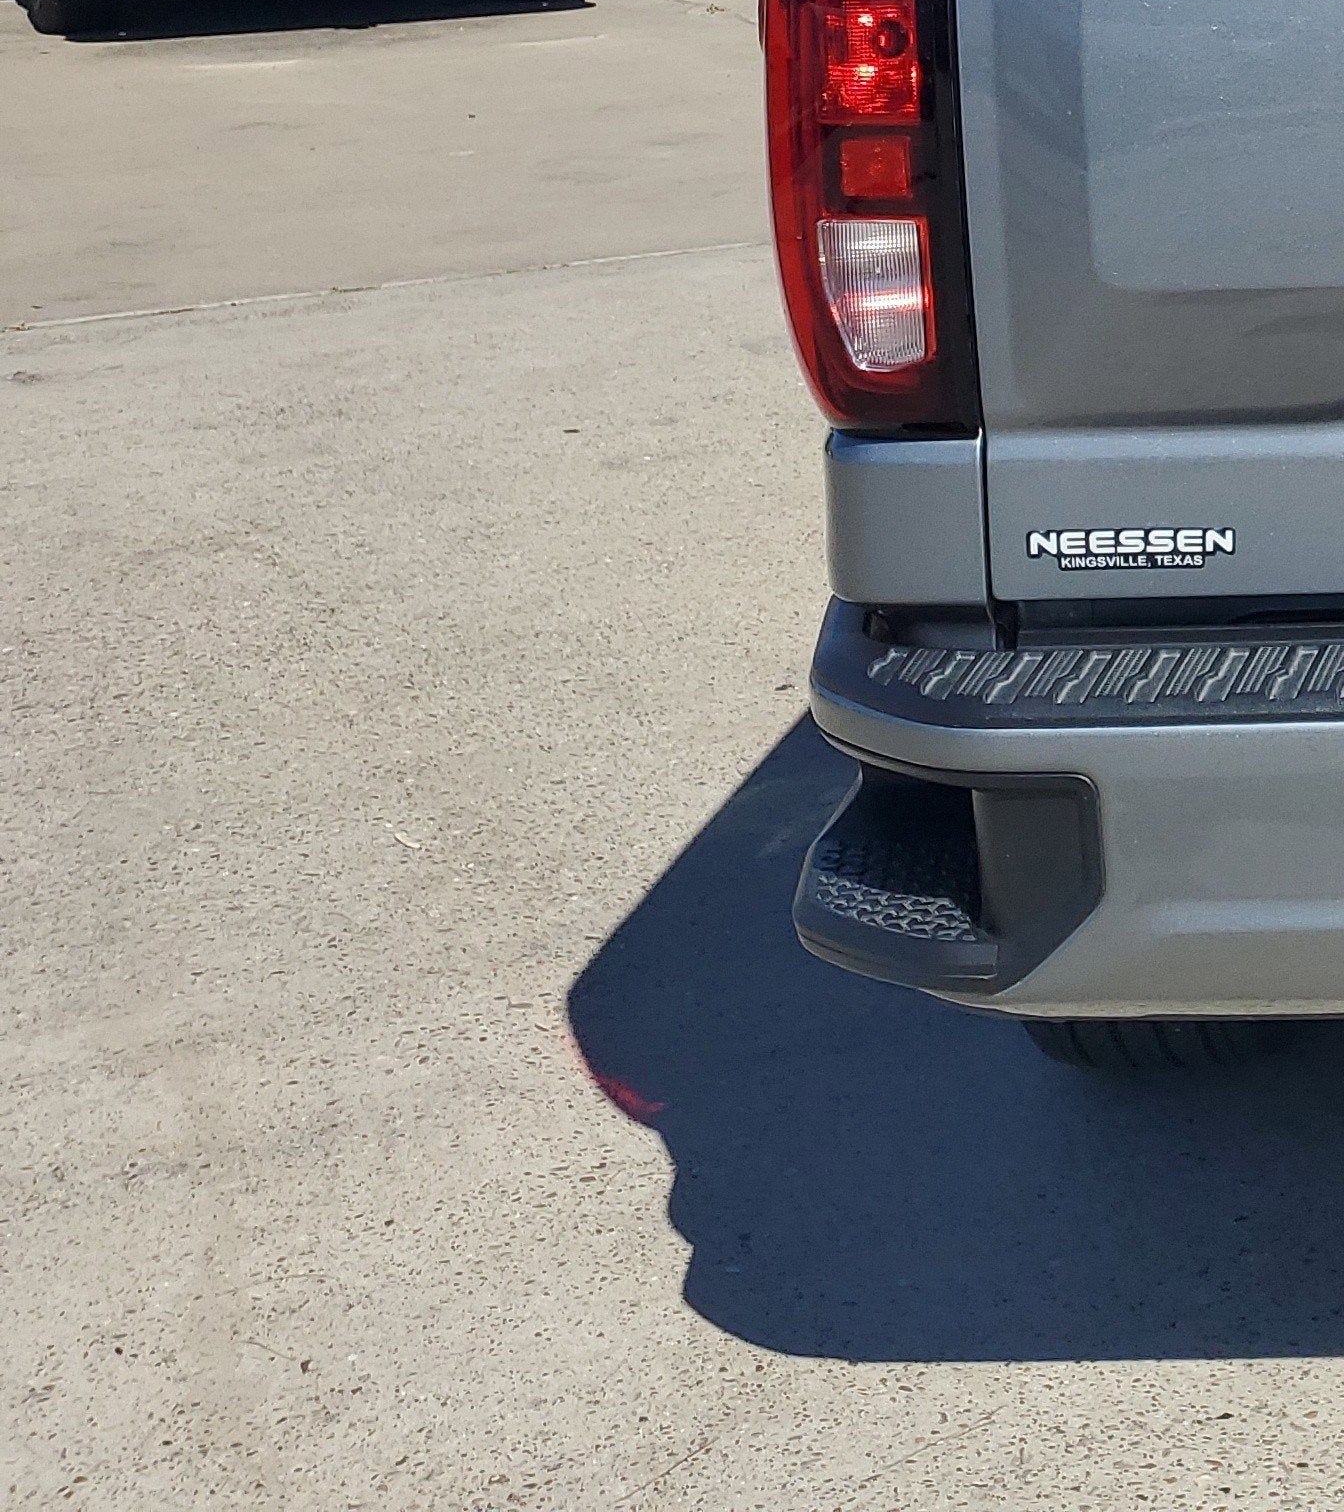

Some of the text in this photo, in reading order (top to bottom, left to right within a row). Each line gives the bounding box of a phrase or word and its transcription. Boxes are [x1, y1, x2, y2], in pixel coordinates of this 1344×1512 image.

[1029, 529, 1234, 556] NEESSEN
[1060, 554, 1204, 569] KINGSVILLE, TEXAS
